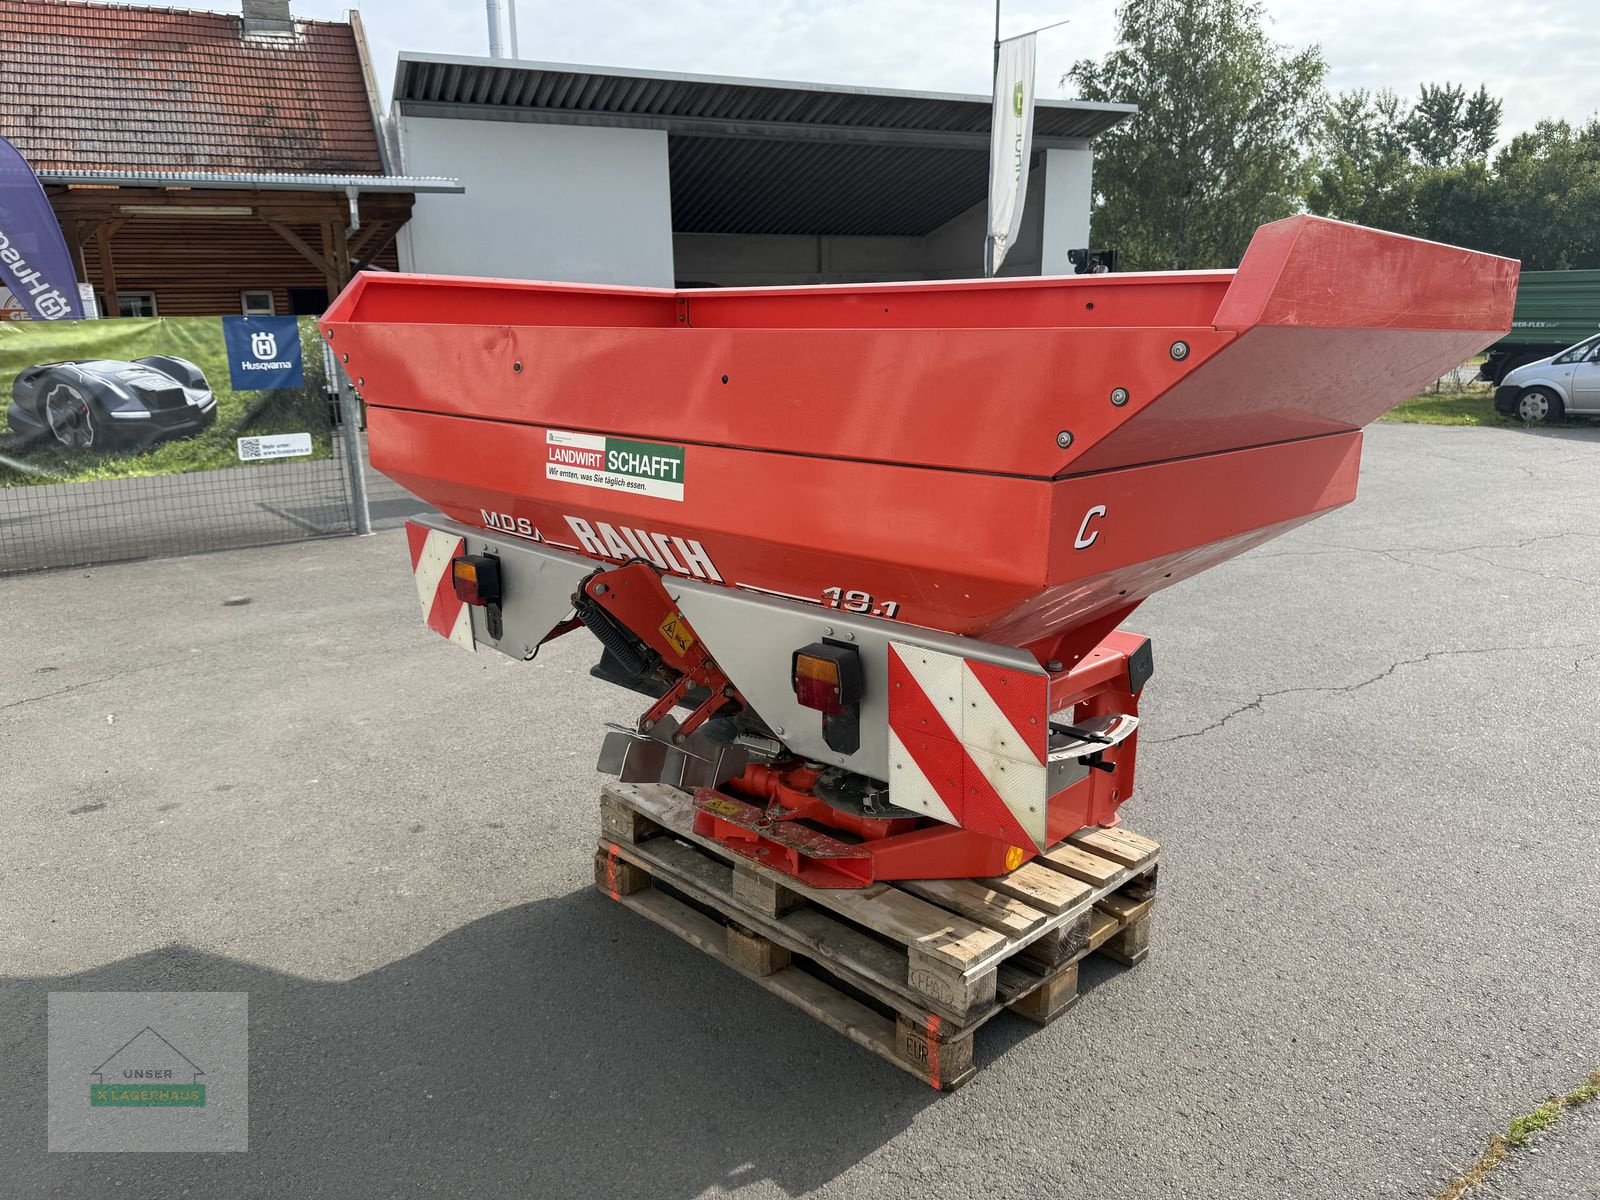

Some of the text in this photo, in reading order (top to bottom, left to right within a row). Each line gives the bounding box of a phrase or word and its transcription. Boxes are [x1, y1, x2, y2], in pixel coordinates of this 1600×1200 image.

[242, 361, 292, 371] Husqvarna
[549, 447, 602, 468] LANDWIRT
[608, 450, 680, 479] SCHAFFT
[549, 467, 646, 490] Wir ernten, was Sie täglich essen.
[480, 509, 533, 536] MDS
[1074, 505, 1107, 550] C
[563, 515, 725, 584] RAUCH
[823, 586, 900, 618] 19.1
